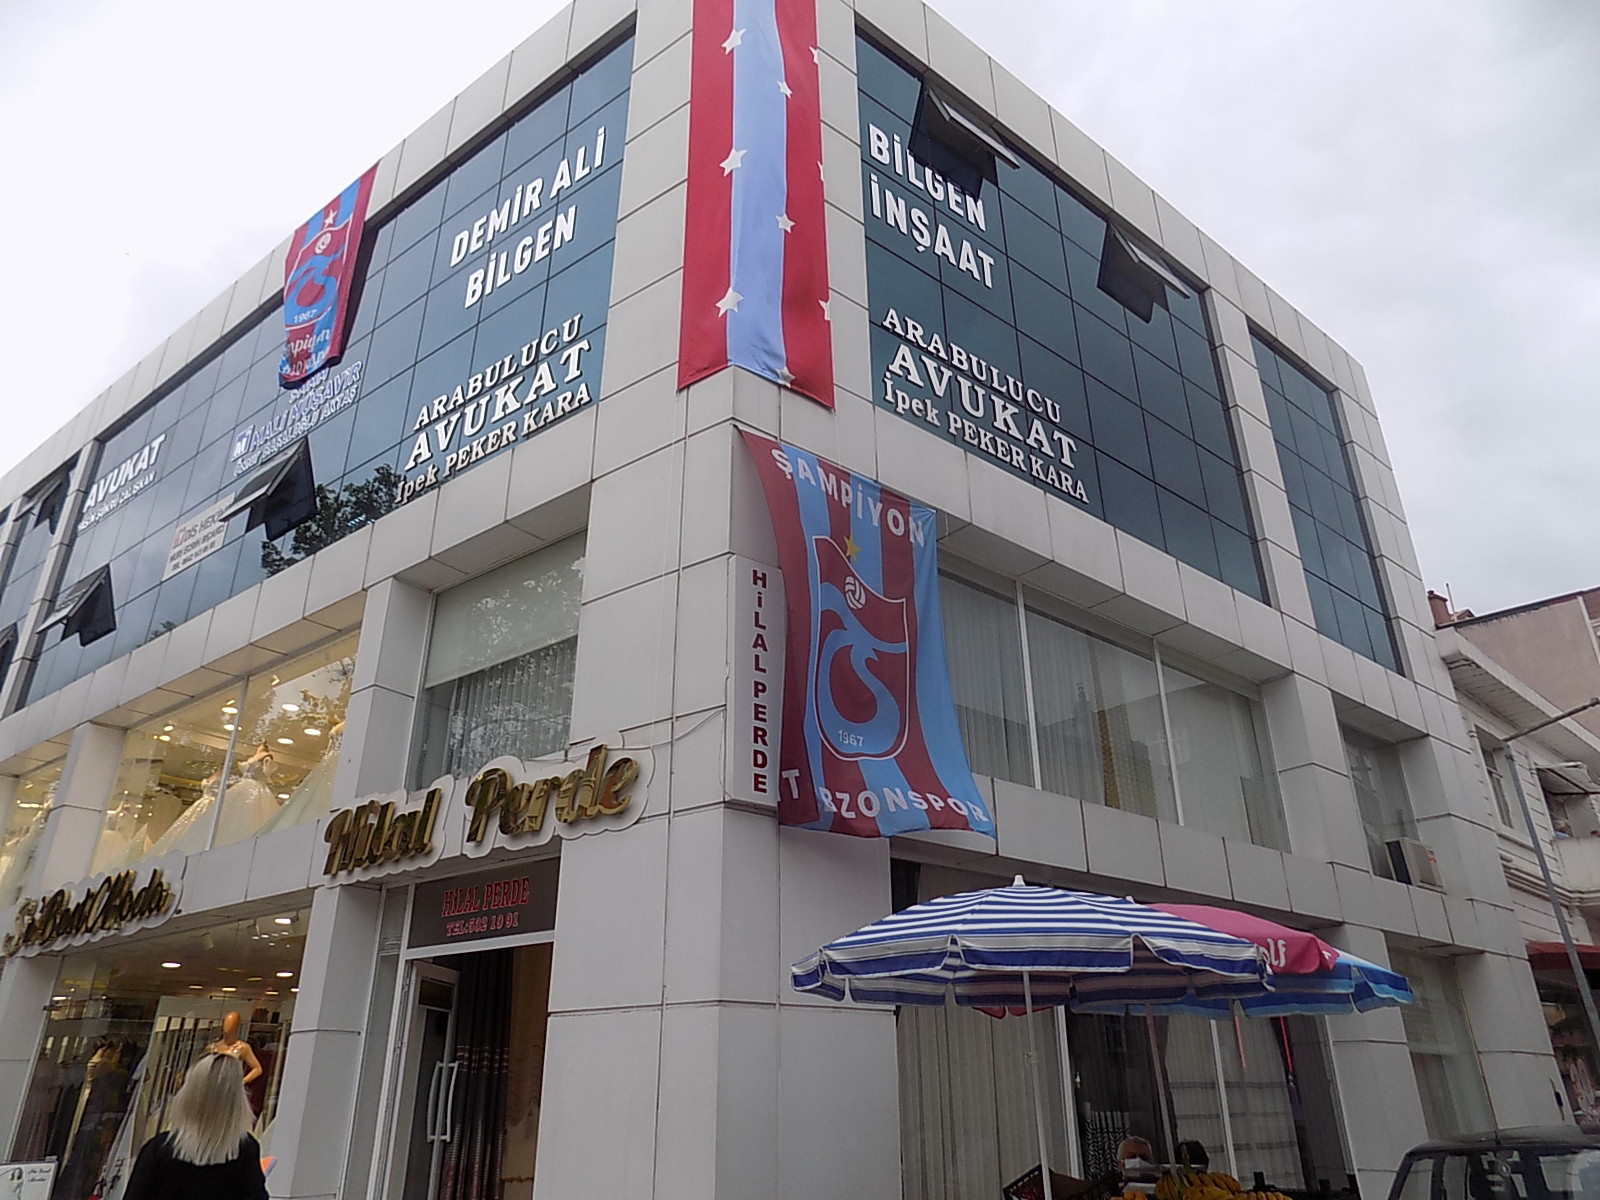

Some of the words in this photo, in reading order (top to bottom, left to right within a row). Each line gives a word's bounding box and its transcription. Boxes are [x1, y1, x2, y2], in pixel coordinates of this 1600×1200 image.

[450, 177, 545, 268] DEMİR
[549, 125, 606, 199] ALİ
[868, 123, 986, 232] BİLGEN
[870, 173, 995, 289] İNŞAAT
[464, 204, 578, 310] BİLGEN
[404, 340, 591, 471] AVUKAT
[413, 314, 583, 431] ARABULUCU
[882, 308, 1061, 423] ARABULUCU
[888, 344, 1078, 469] AVUKAT
[82, 432, 167, 514] AVUKAT
[442, 420, 517, 478] PEKER
[521, 382, 591, 436] KARA
[884, 372, 941, 427] İpek
[946, 411, 1027, 472] PEKER
[1028, 454, 1090, 504] KARA
[771, 449, 925, 547] ŞAMPİYON
[752, 680, 768, 794] PERDE
[838, 729, 864, 747] 1967
[323, 787, 443, 877] Hilal
[465, 743, 640, 843] Perde
[781, 768, 990, 823] TBZONSPOR
[482, 875, 530, 911] PERDE
